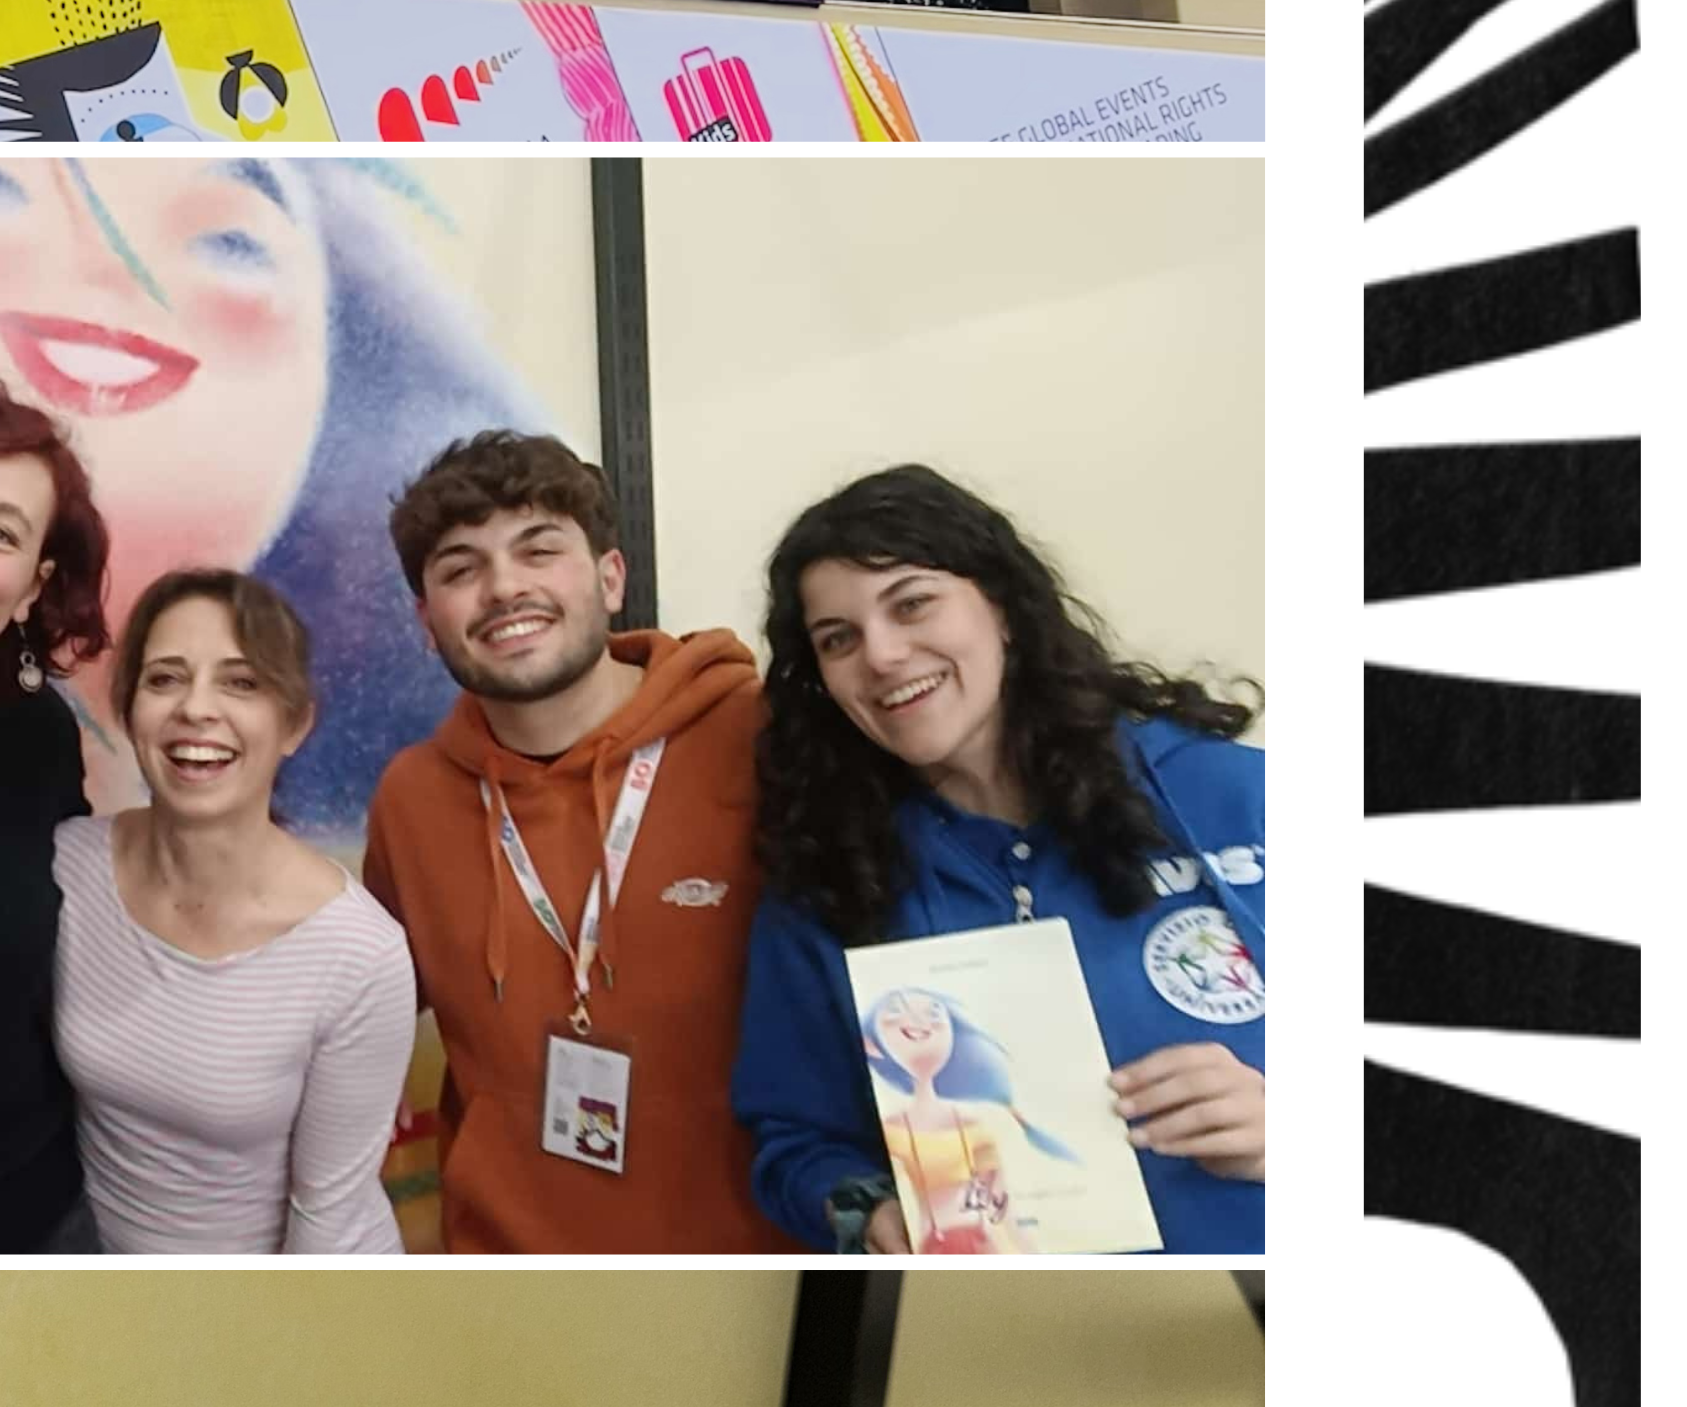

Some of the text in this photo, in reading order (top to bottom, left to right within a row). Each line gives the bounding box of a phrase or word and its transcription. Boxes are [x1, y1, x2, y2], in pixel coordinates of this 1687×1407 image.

[1017, 75, 1171, 142] GLOBAL EVENTS
[1158, 82, 1229, 125] RIGHTS
